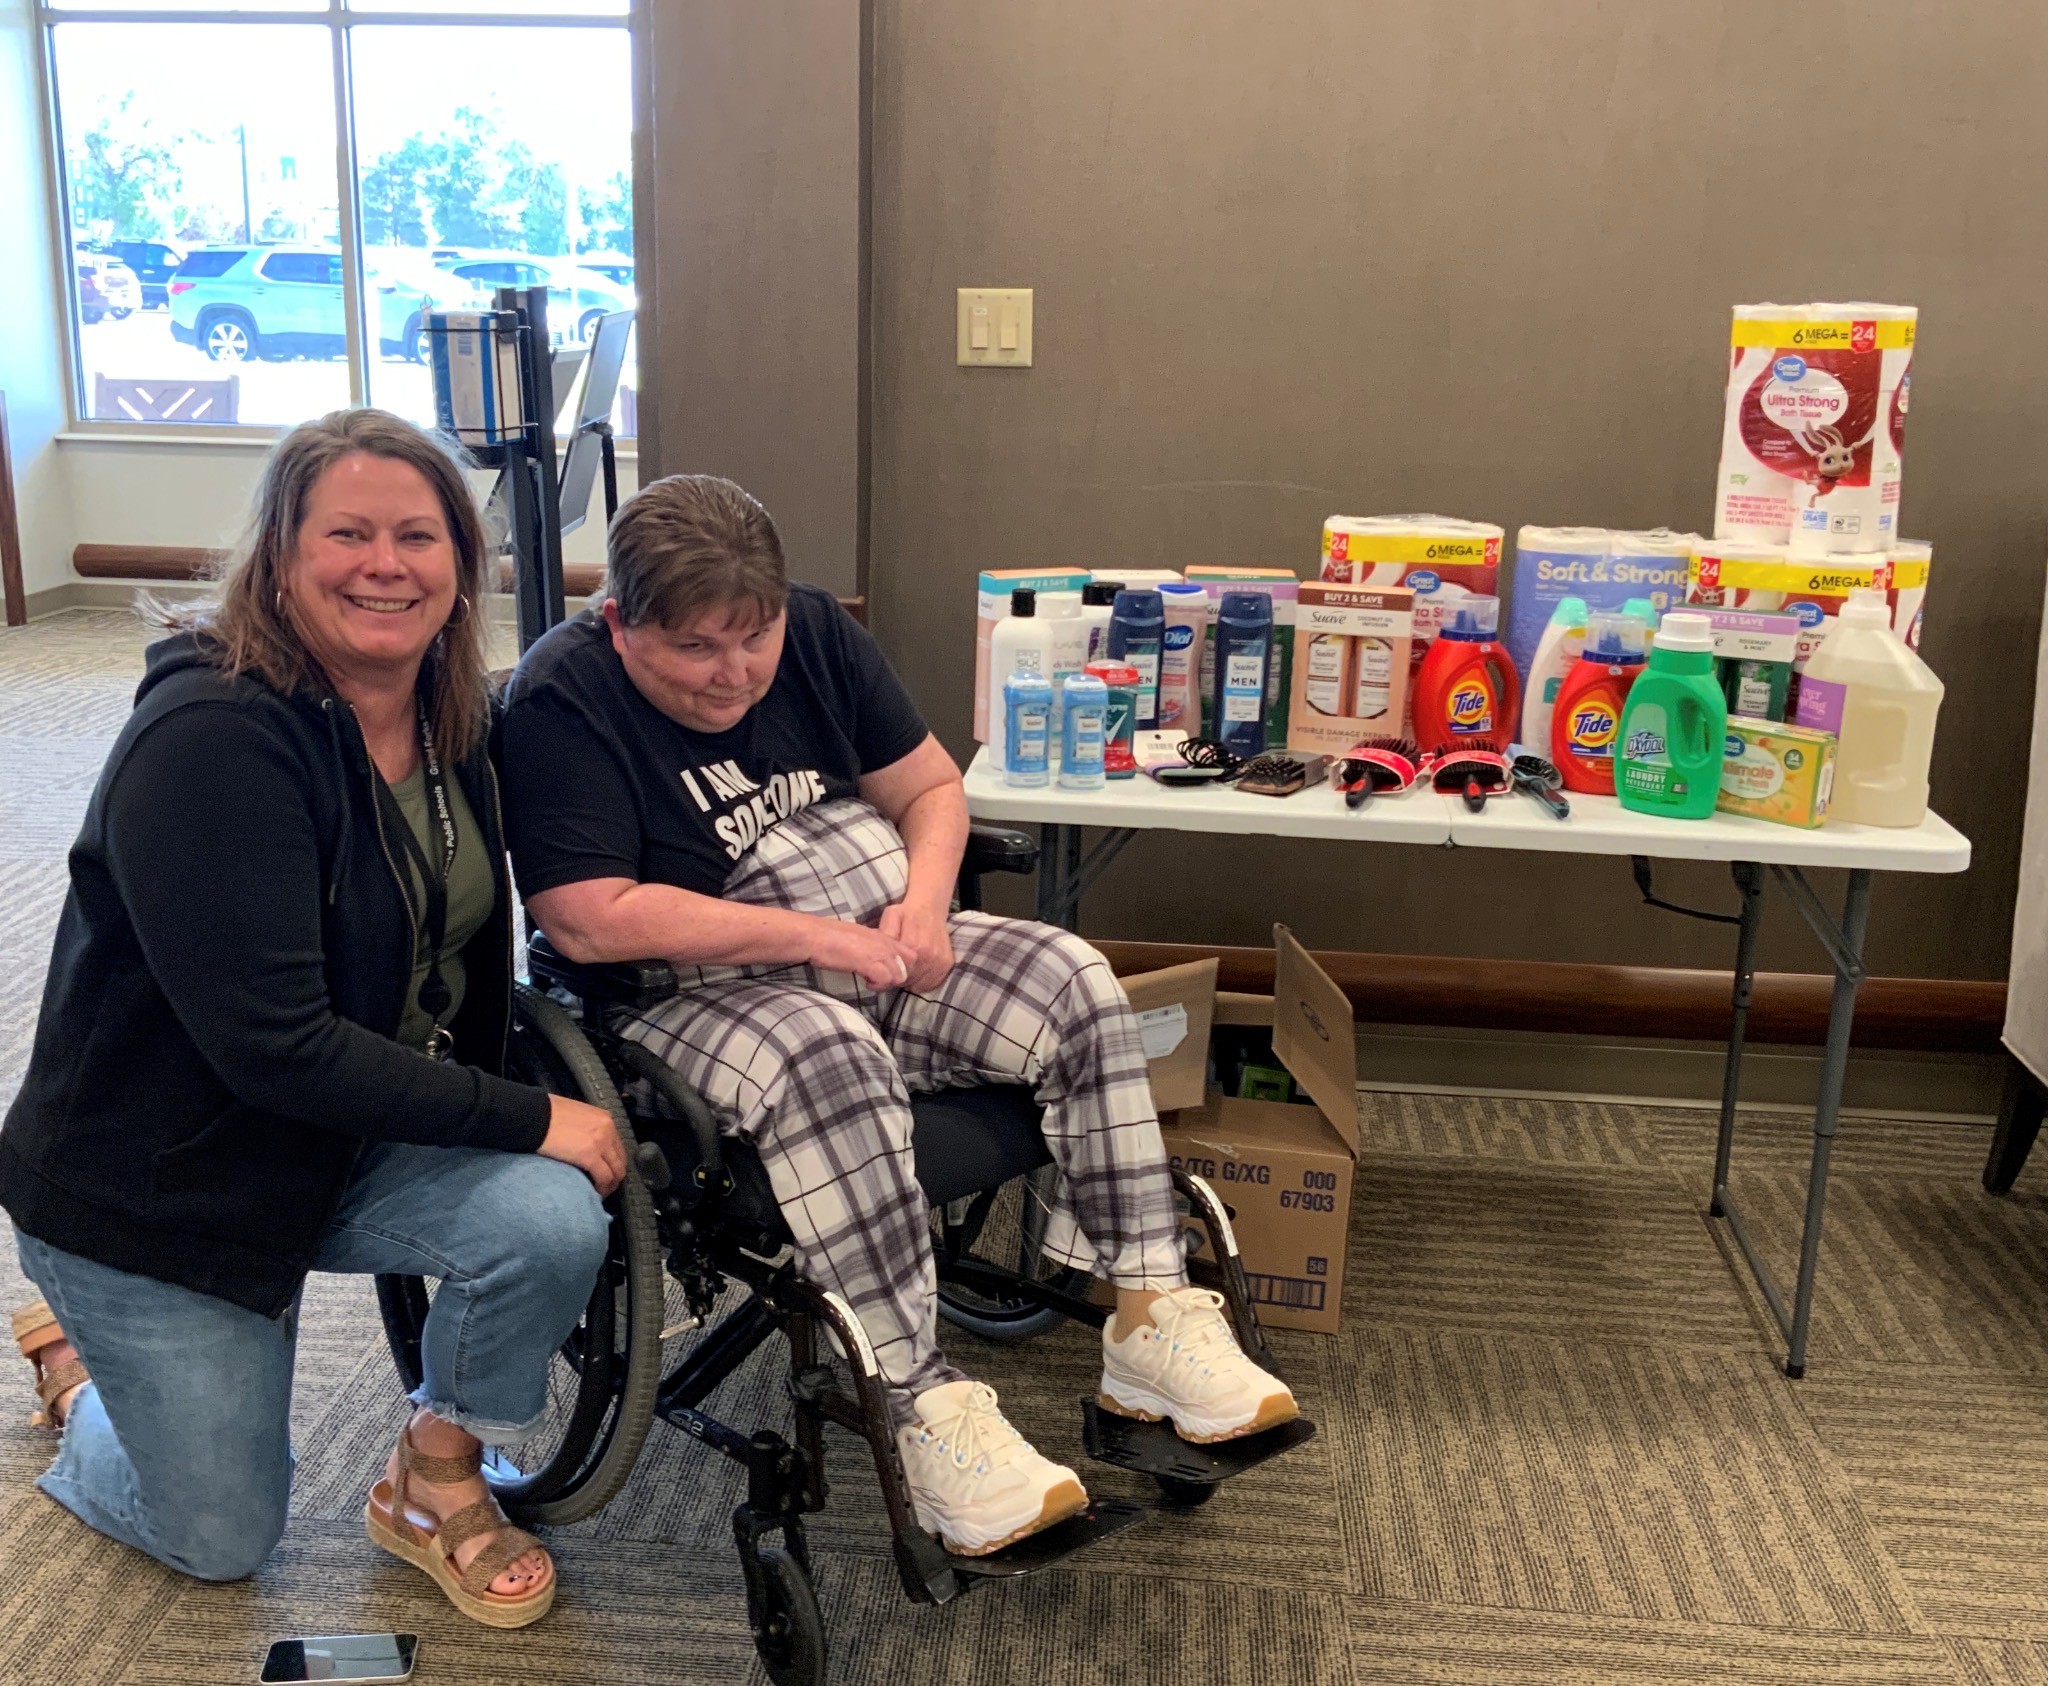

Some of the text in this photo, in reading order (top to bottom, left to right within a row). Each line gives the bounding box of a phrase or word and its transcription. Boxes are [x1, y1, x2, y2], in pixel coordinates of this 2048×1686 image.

[1793, 329, 1804, 344] 6
[1805, 328, 1839, 340] MEGA
[1852, 326, 1875, 341] 24
[1767, 394, 1840, 412] Ultra Strong
[1780, 409, 1823, 419] Bath Tissue
[1331, 537, 1347, 552] 24
[1426, 544, 1437, 559] 6
[1438, 545, 1474, 556] MEGA
[1537, 559, 1688, 590] Soft & Strong
[1701, 562, 1719, 577] 24
[1410, 575, 1434, 585] Great
[1809, 575, 1821, 590] 6
[1821, 577, 1861, 588] MEGA
[1324, 592, 1342, 602] BUY
[1344, 594, 1350, 603] 2
[1351, 594, 1359, 603] &
[1360, 595, 1384, 605] SAVE
[1311, 610, 1348, 625] Suave
[1721, 615, 1728, 624] 2
[1730, 615, 1738, 624] &
[1740, 617, 1765, 627] SAVE
[1164, 631, 1193, 645] Dial
[1315, 648, 1337, 659] Suave
[1232, 662, 1259, 672] Suave
[1138, 676, 1153, 684] EN
[1230, 677, 1258, 687] MEN
[1454, 691, 1485, 717] Tide
[1295, 726, 1326, 735] VISIBLE
[1326, 728, 1360, 738] DAMAGE
[1574, 712, 1614, 738] Tide
[1627, 731, 1665, 760] OXYDOL
[1626, 769, 1666, 783] LAUNDRY
[680, 759, 762, 813] I AM
[1625, 778, 1665, 791] DETERGENT
[433, 784, 450, 820] Schools
[442, 819, 455, 848] Public
[1222, 1161, 1271, 1185] G/XG
[1303, 1170, 1336, 1191] 000
[1280, 1190, 1334, 1213] 67903
[1308, 1258, 1326, 1273] 56
